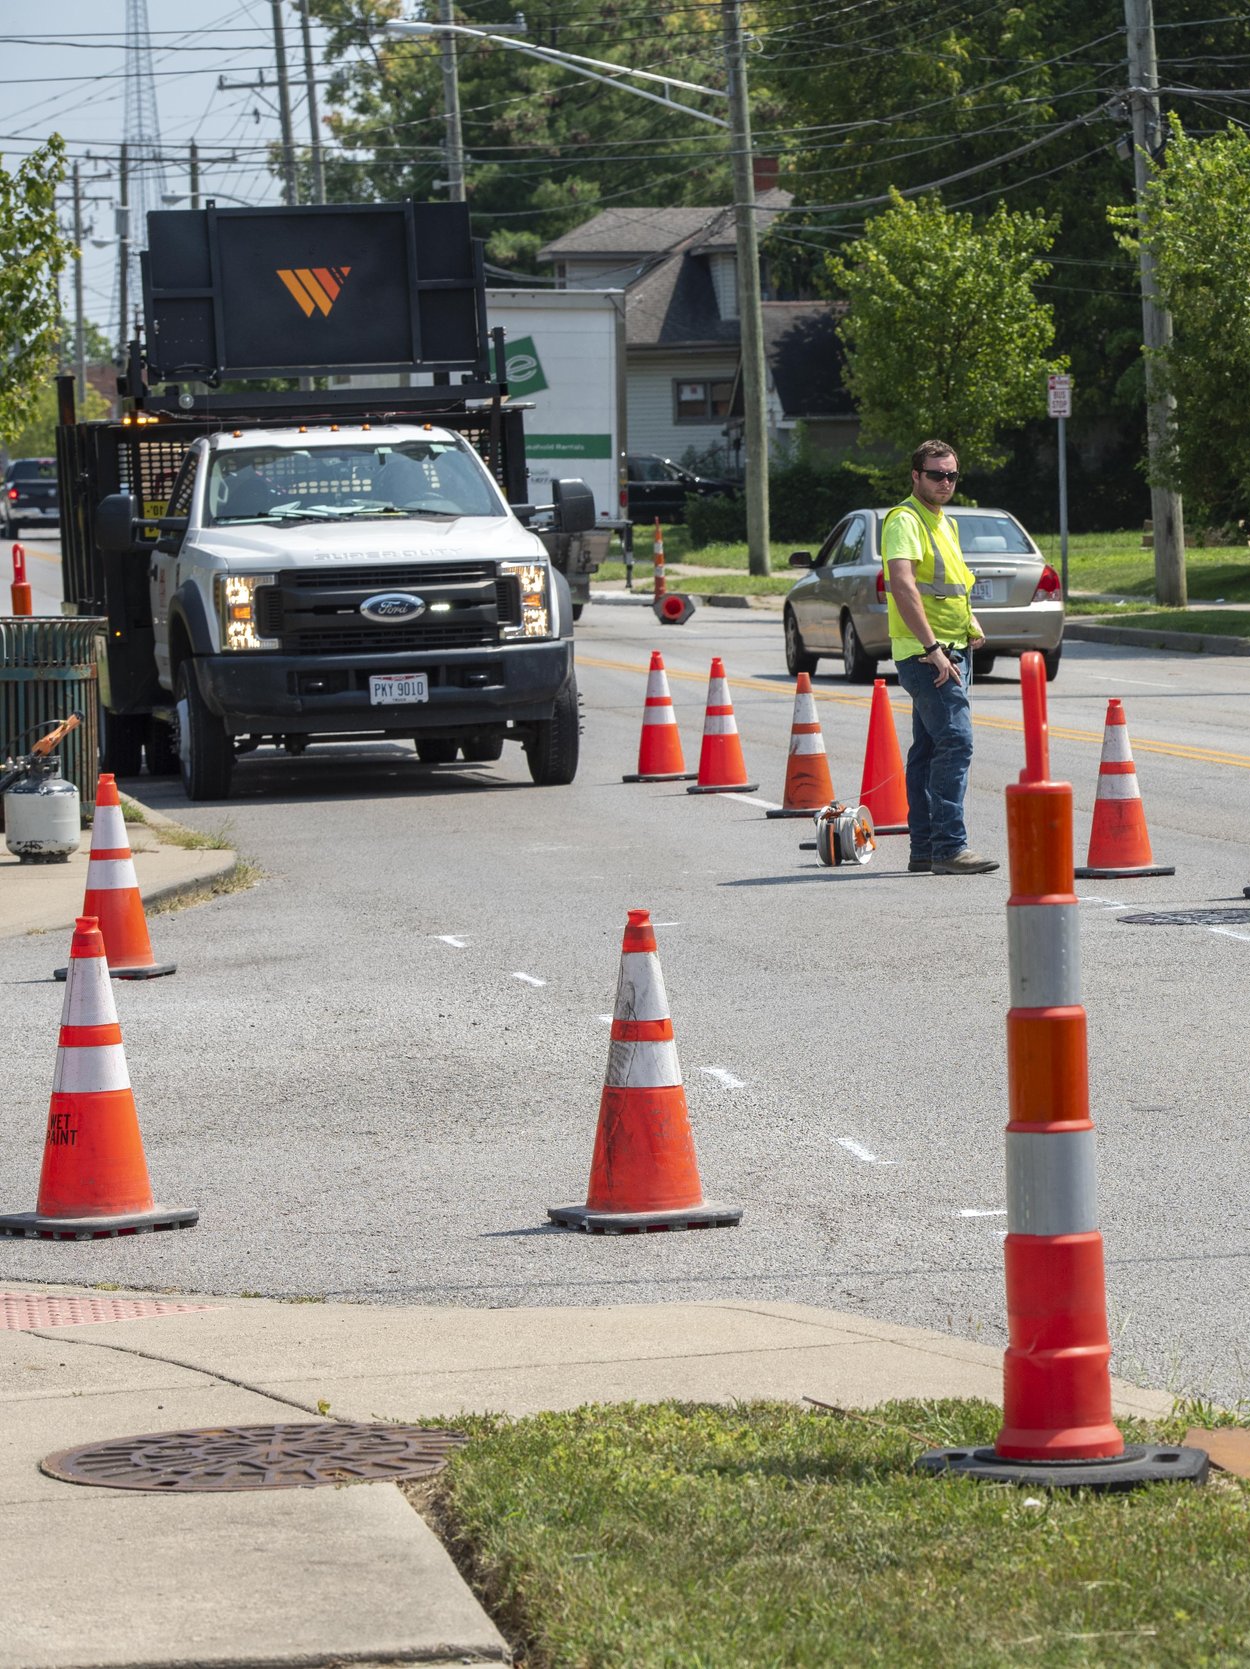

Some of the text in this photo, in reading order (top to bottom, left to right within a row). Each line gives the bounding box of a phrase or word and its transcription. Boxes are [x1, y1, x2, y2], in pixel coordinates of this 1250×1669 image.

[1053, 390, 1067, 400] BUS
[1052, 400, 1068, 409] STOP
[314, 547, 463, 561] SUPER DUTY
[378, 601, 408, 615] Ford
[374, 681, 424, 698] PKY 9010
[50, 1113, 71, 1130] WET
[46, 1129, 78, 1146] PAINT
